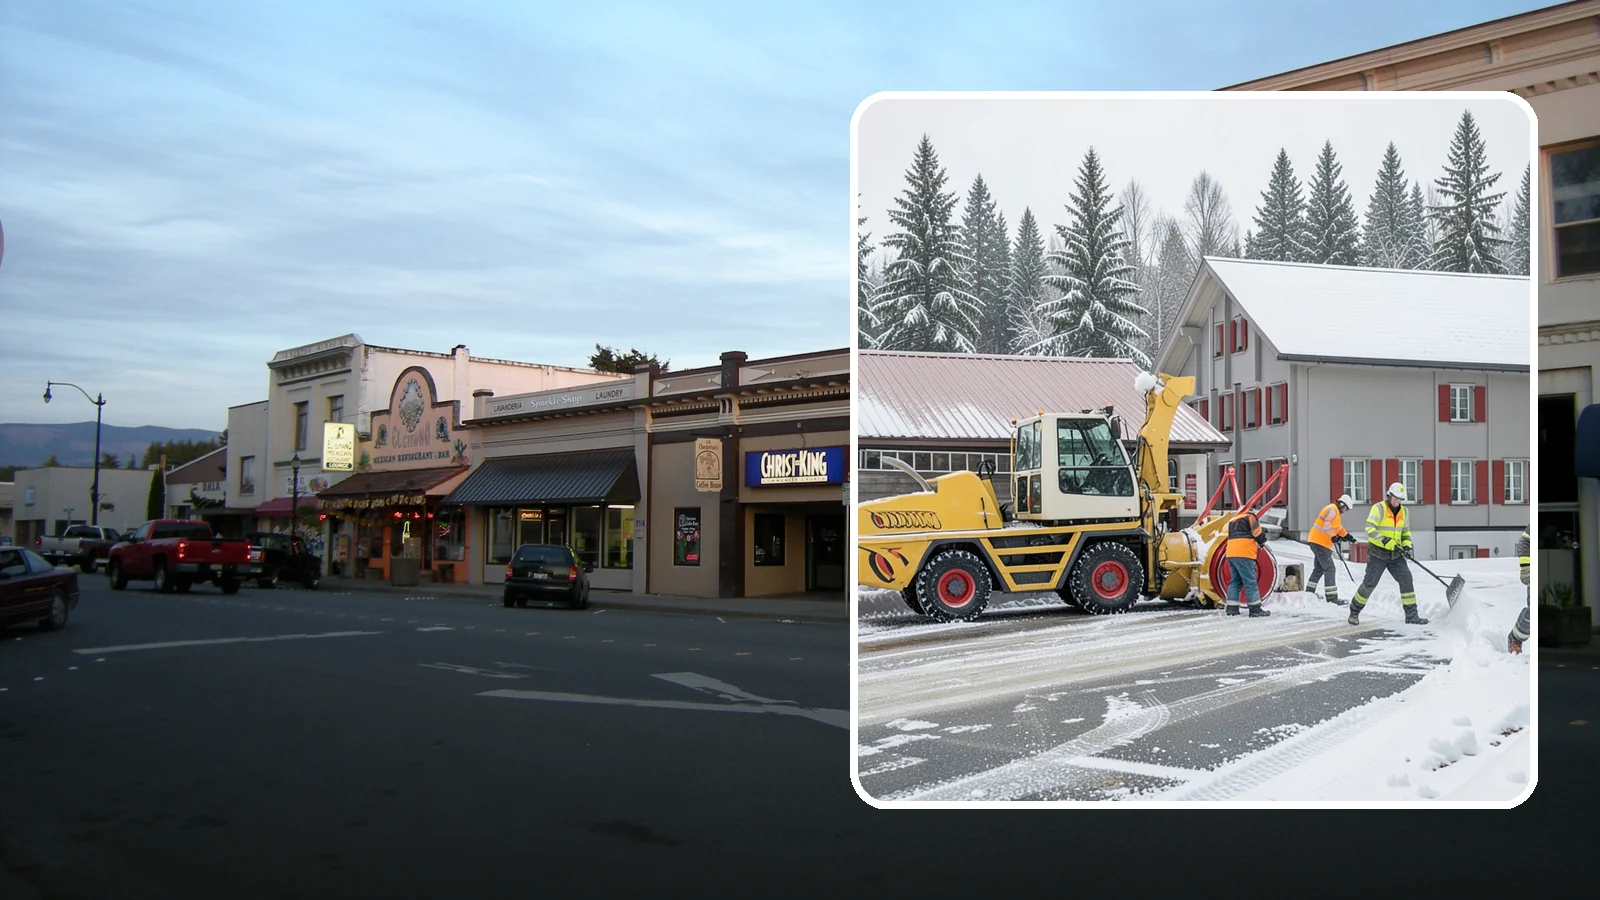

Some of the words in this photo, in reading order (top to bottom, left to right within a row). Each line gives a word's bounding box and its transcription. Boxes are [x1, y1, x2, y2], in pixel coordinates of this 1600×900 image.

[493, 402, 522, 412] LAVANDERIA
[562, 394, 582, 405] Shop
[596, 390, 623, 400] LAUNDRY
[373, 455, 396, 464] MEXICAN
[397, 451, 433, 463] RESTAURANT
[438, 450, 450, 459] BAR
[760, 452, 797, 478] CHRIST
[799, 449, 827, 476] KING
